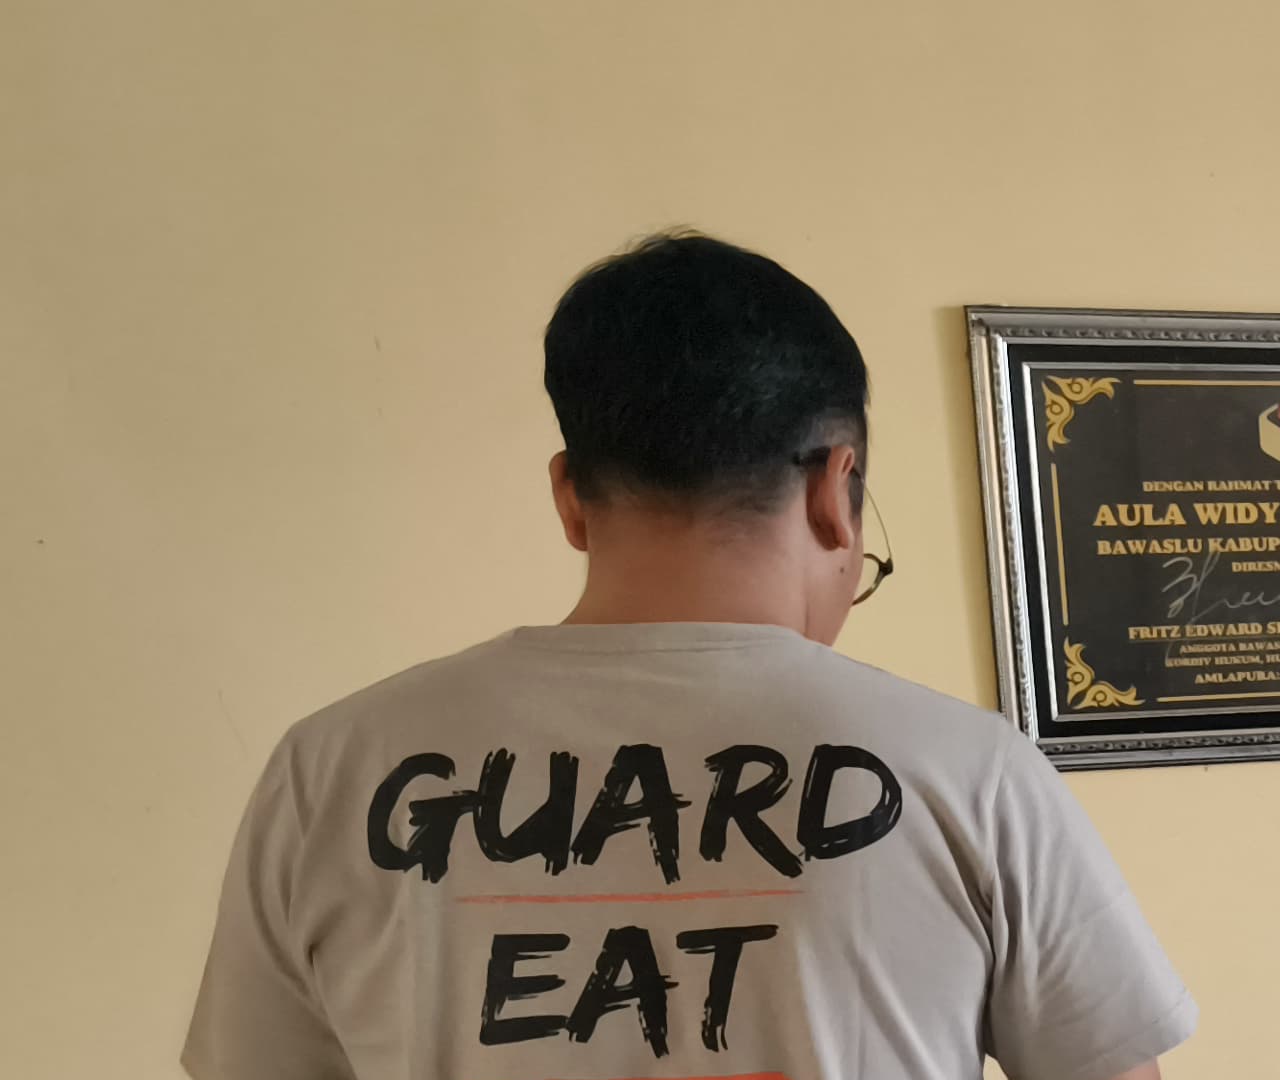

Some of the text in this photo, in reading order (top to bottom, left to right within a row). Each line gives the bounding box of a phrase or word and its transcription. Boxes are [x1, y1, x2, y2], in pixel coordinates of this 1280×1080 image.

[1143, 481, 1204, 493] DENGAN
[1207, 480, 1271, 492] RAHMAT
[1093, 503, 1187, 527] AULA
[1097, 538, 1203, 556] BAWASLU
[1128, 625, 1181, 640] FRITZ
[1185, 622, 1263, 637] EDWARD
[367, 743, 903, 884] GUARD
[479, 923, 780, 1059] EAT
